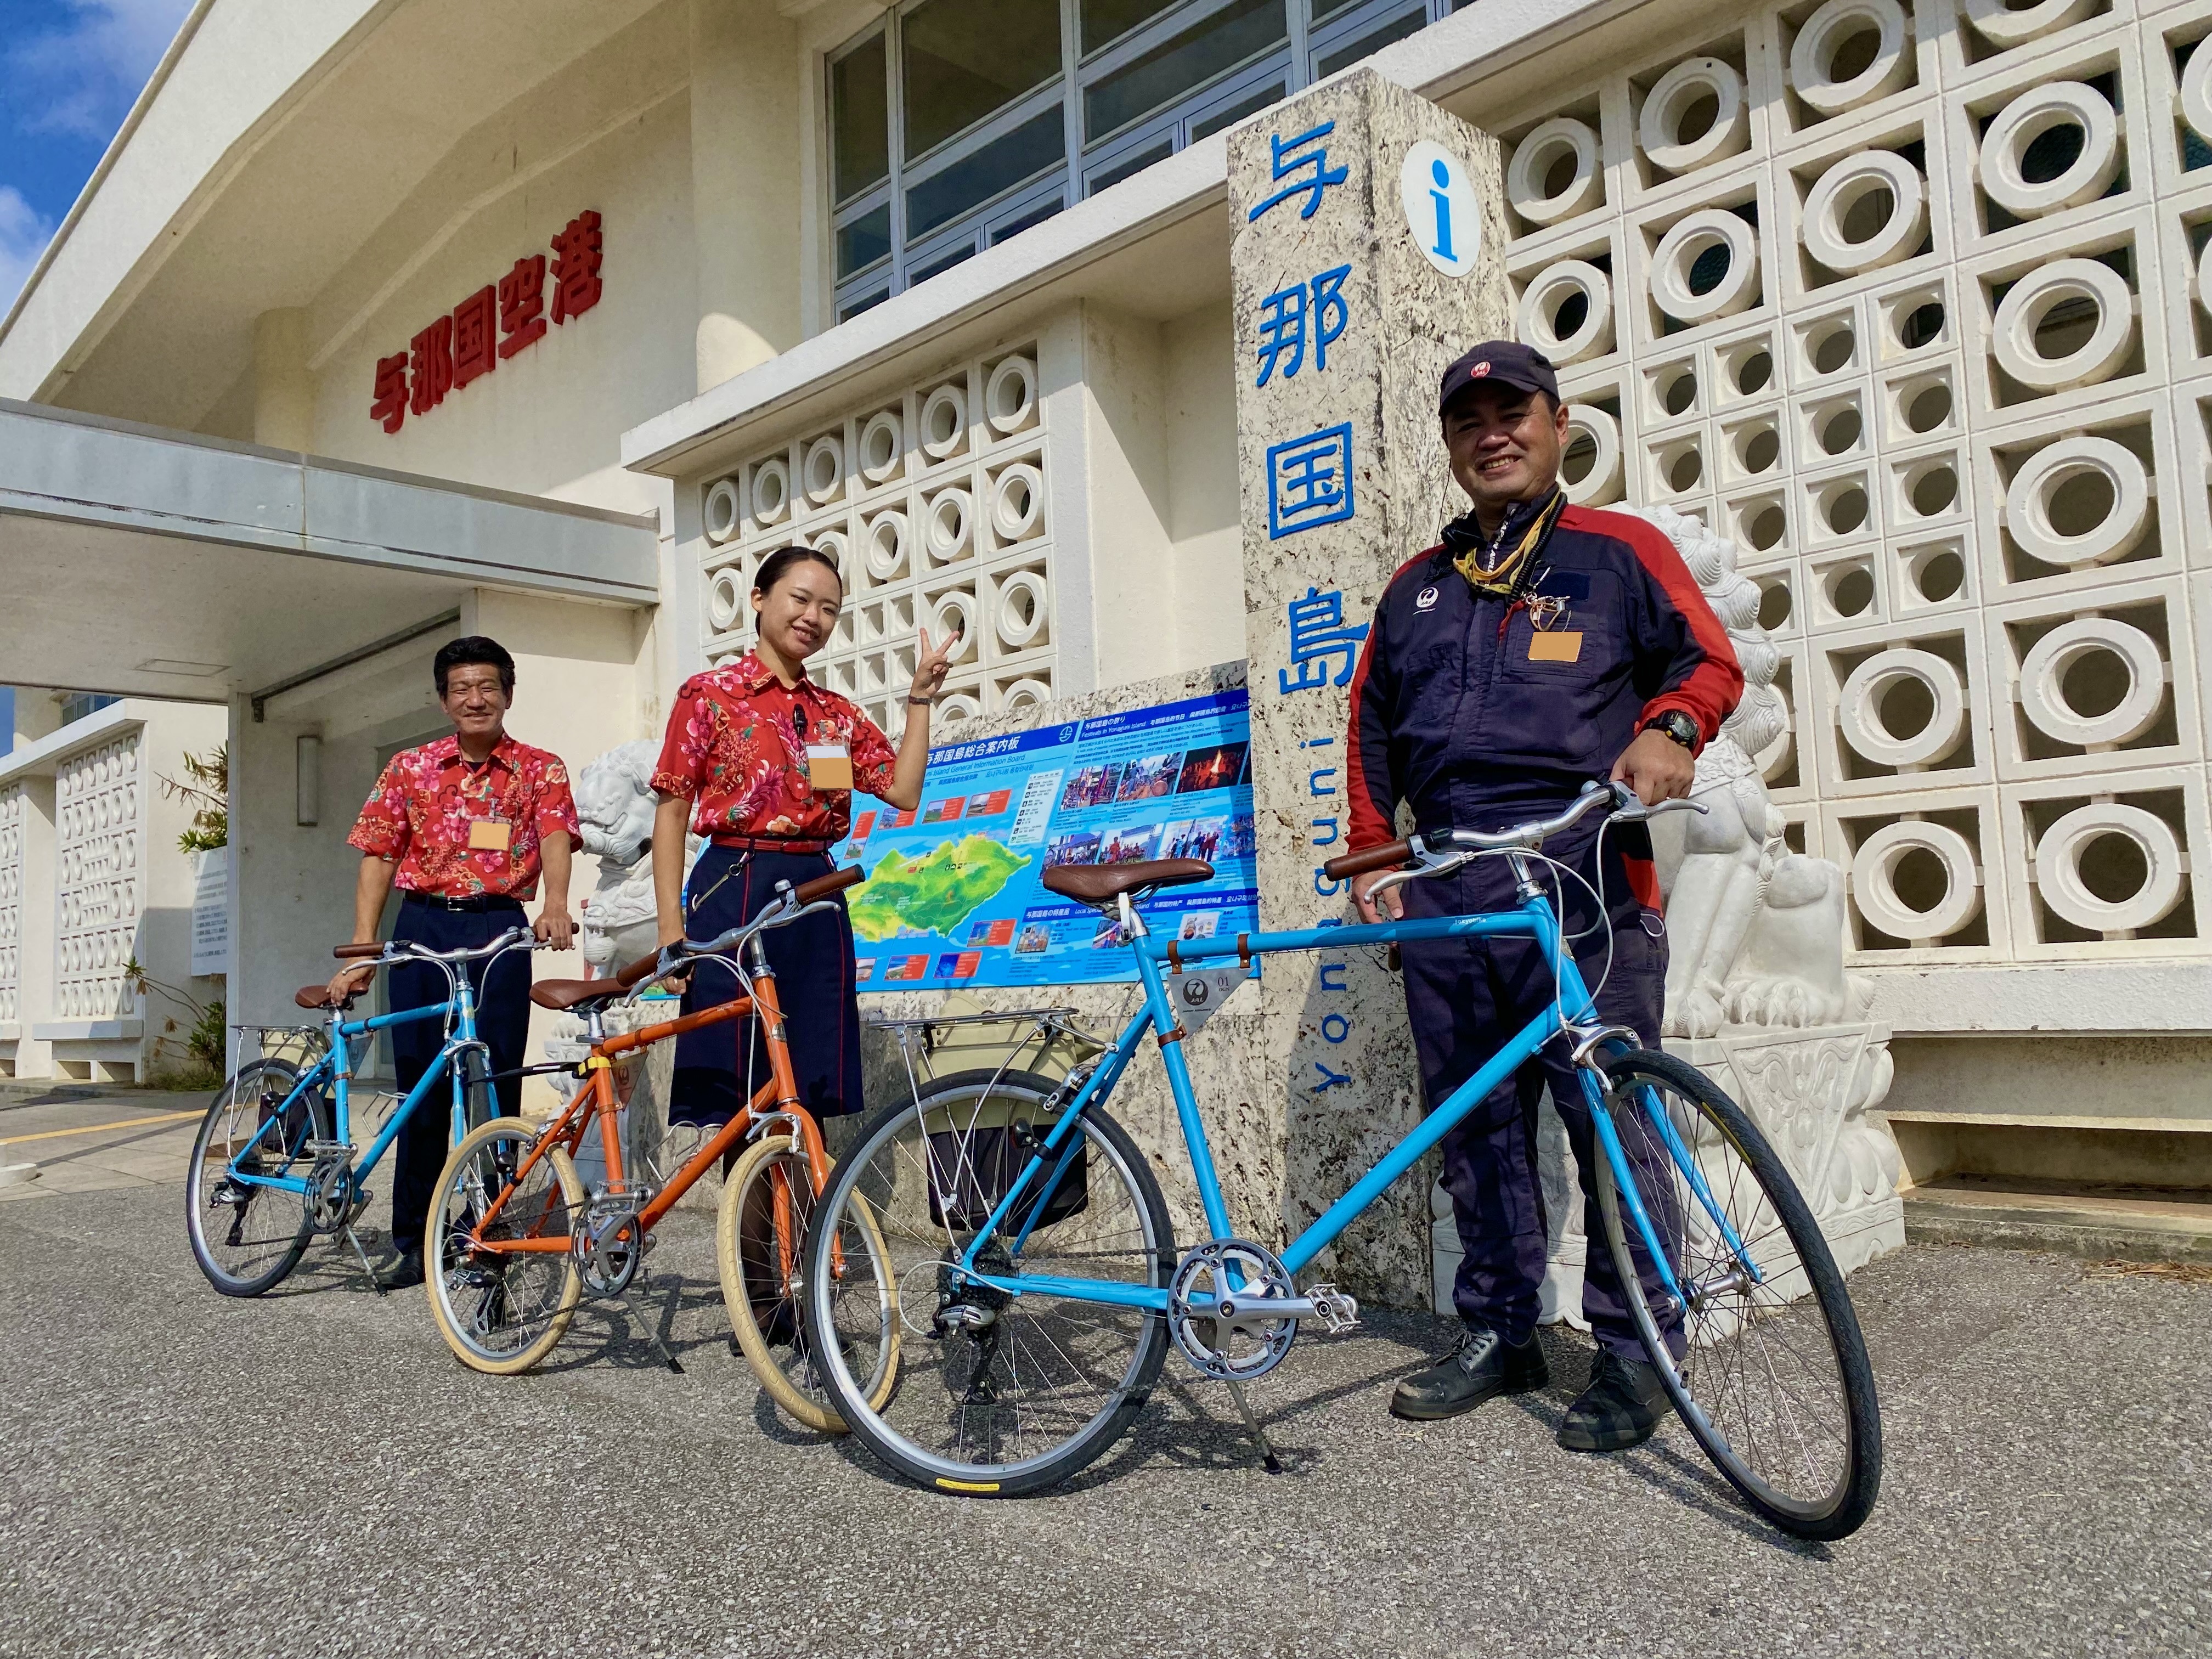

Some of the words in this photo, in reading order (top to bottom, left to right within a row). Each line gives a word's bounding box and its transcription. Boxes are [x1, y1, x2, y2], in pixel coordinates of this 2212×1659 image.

[370, 209, 603, 434] 与那国空港
[1248, 120, 1370, 696] 与那国島
[1081, 729, 1102, 738] Festivals
[1108, 724, 1130, 732] Yonaguni
[933, 766, 950, 776] Island
[950, 763, 973, 772] General
[973, 758, 1007, 769] Information
[1007, 754, 1026, 763] Board
[1455, 917, 1487, 925] tokyobike
[1217, 976, 1229, 987] 01
